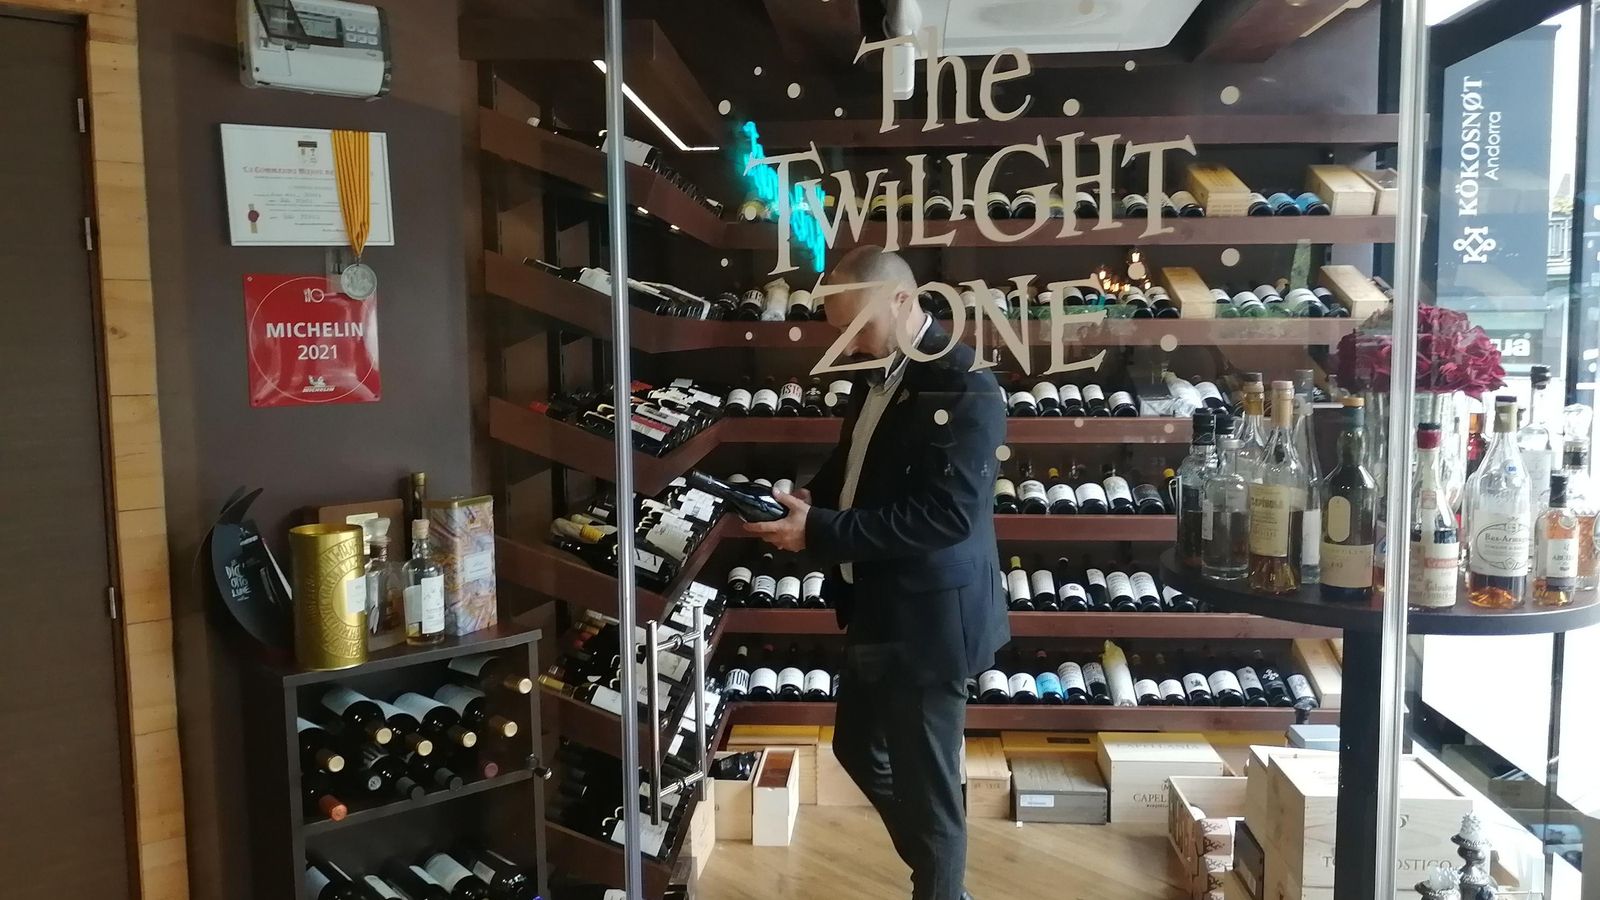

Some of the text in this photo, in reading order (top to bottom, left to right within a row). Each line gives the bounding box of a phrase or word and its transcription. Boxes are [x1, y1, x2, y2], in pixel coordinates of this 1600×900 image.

[853, 28, 1034, 134] The
[1455, 76, 1485, 217] KÖKOSNØT
[1484, 111, 1502, 181] Andorra
[266, 322, 364, 338] MICHELIN
[297, 345, 338, 360] 2021
[808, 271, 1108, 377] ZONE
[1133, 793, 1167, 803] CAPEL
